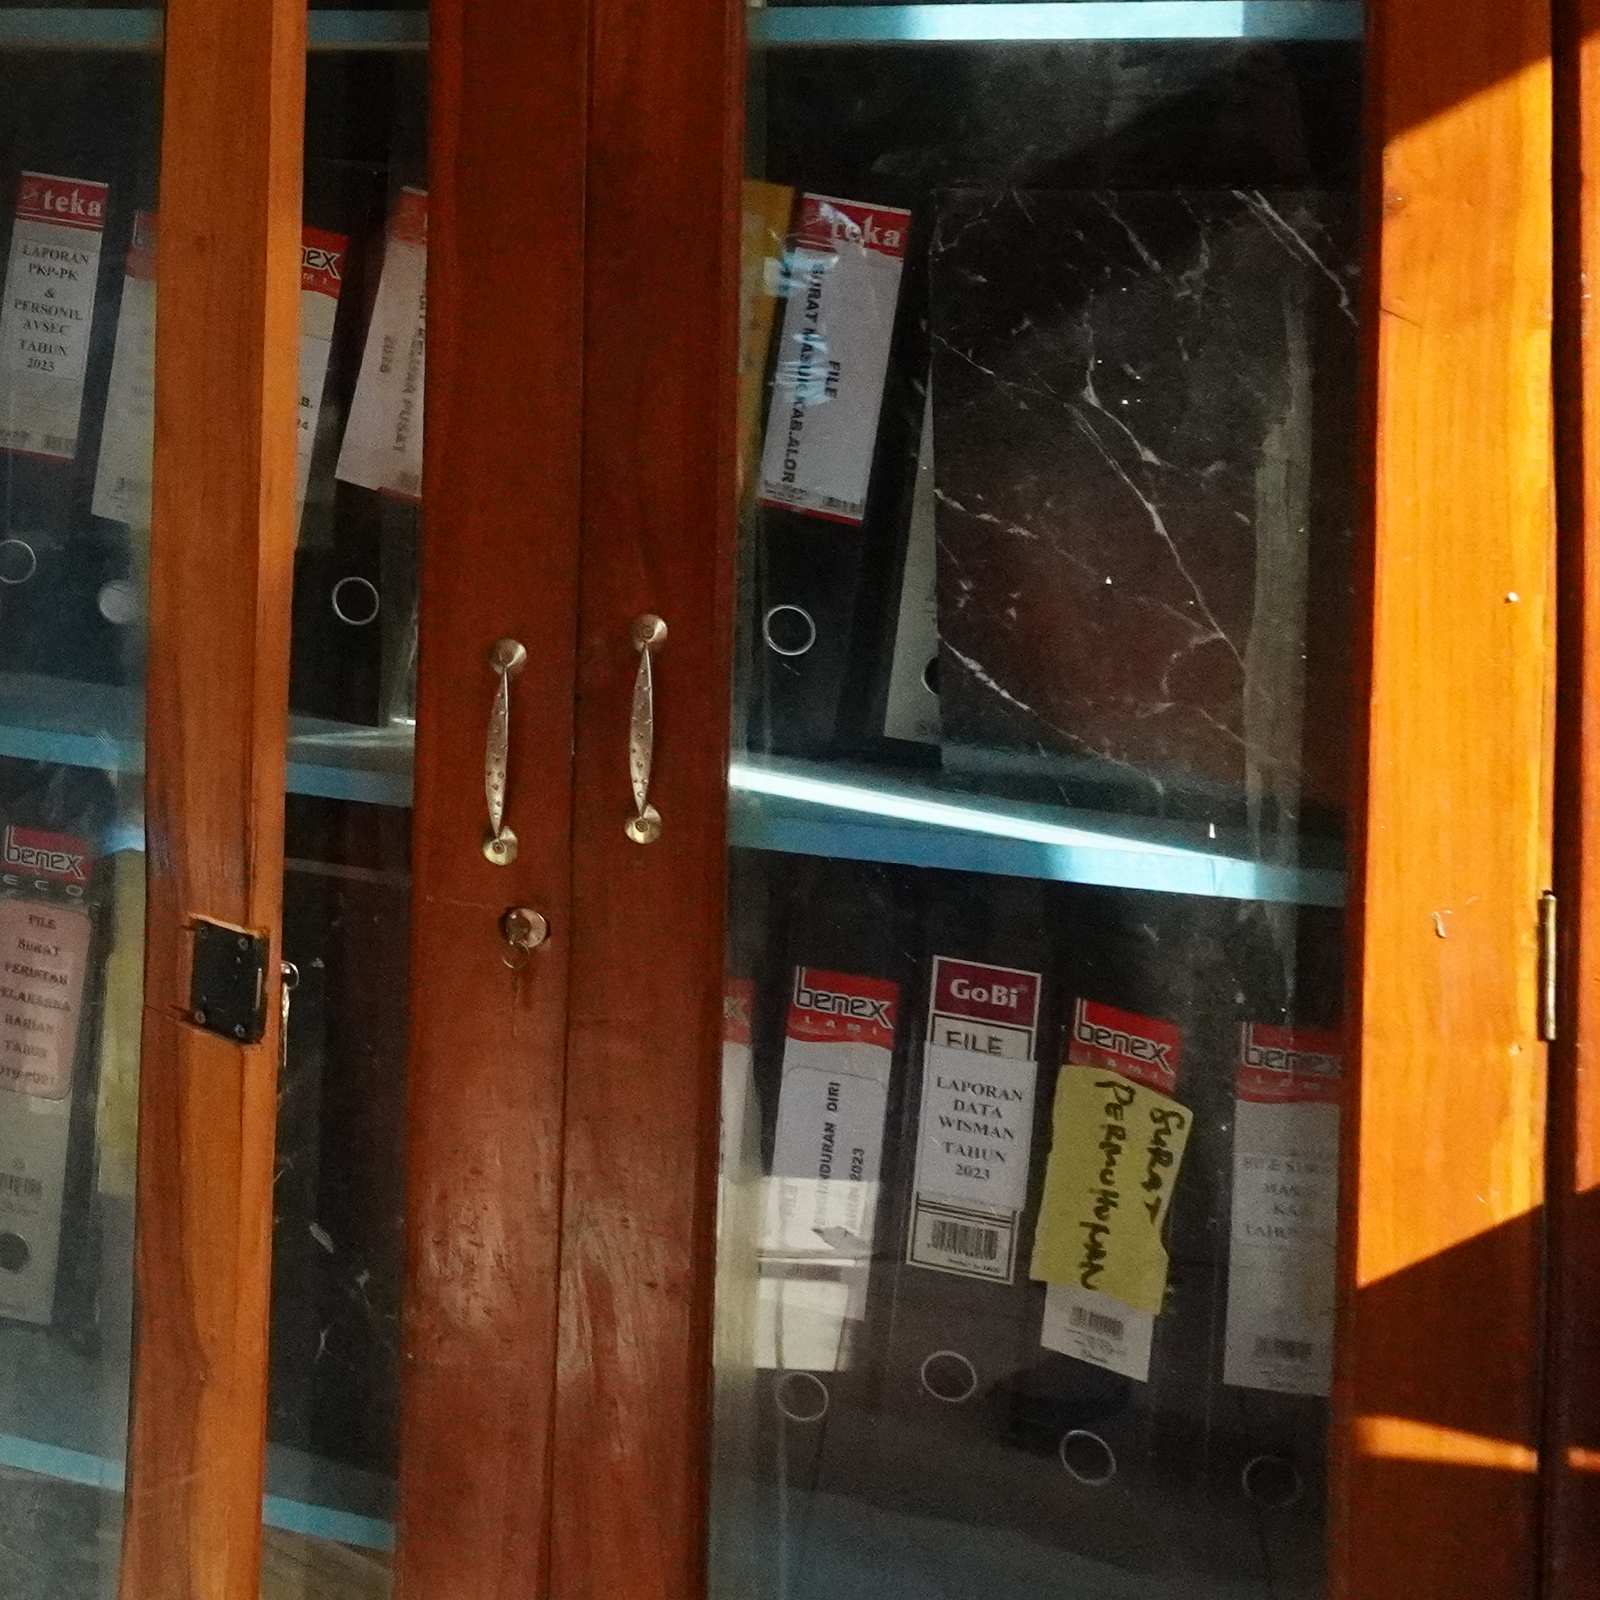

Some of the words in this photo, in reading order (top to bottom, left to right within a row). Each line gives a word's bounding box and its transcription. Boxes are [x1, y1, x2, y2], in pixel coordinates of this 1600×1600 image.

[43, 188, 104, 217] teka
[22, 244, 89, 265] LAPORAN
[29, 263, 78, 281] PKP-PK
[14, 298, 83, 321] PERSONIL
[22, 319, 71, 335] AVSEC
[19, 338, 67, 356] TAHUN
[27, 357, 55, 372] 2023
[823, 361, 841, 398] FILE
[4, 825, 86, 881] benex
[2, 873, 83, 898] ECO
[28, 914, 57, 930] FILE
[794, 964, 894, 1030] benex
[950, 977, 1019, 1009] GoBi
[946, 1030, 1004, 1056] FILE
[1075, 997, 1176, 1076] benex
[826, 1081, 841, 1112] DIRI
[936, 1076, 1023, 1101] LAPORAN
[954, 1098, 1003, 1119] DATA
[938, 1115, 1014, 1141] WISMAN
[849, 1148, 864, 1181] 2023
[943, 1142, 1006, 1163] TAHUN
[955, 1163, 991, 1181] 2023
